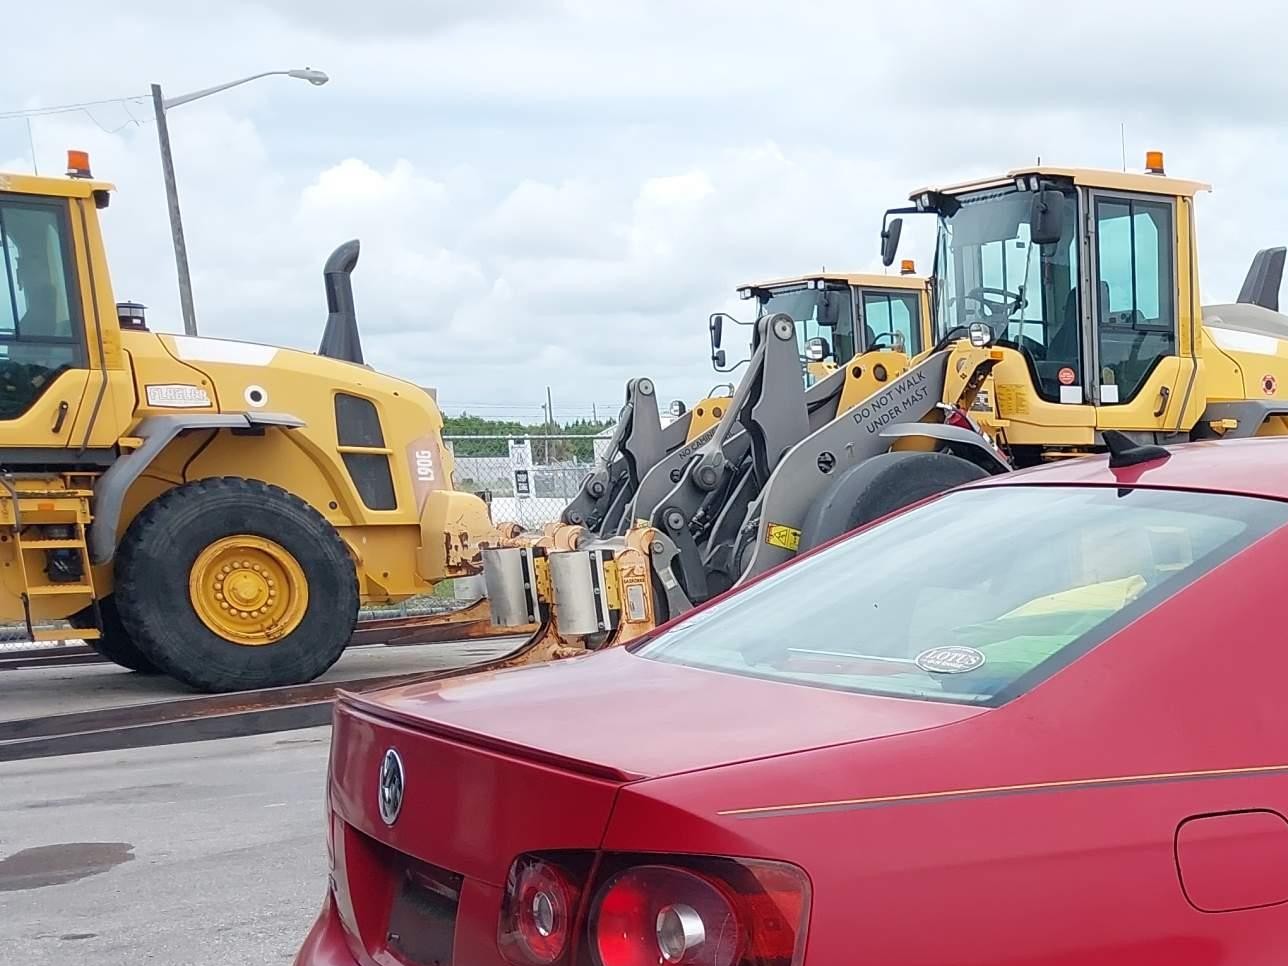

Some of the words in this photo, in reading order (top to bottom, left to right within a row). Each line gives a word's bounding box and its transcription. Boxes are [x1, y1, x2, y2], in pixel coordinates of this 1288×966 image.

[853, 408, 870, 424] DO
[871, 391, 895, 412] NOT
[895, 371, 926, 395] WALK
[866, 406, 902, 433] UNDER
[902, 386, 928, 410] MAST
[415, 450, 435, 481] L90G
[679, 448, 691, 459] NO
[925, 650, 980, 665] LOTUS
